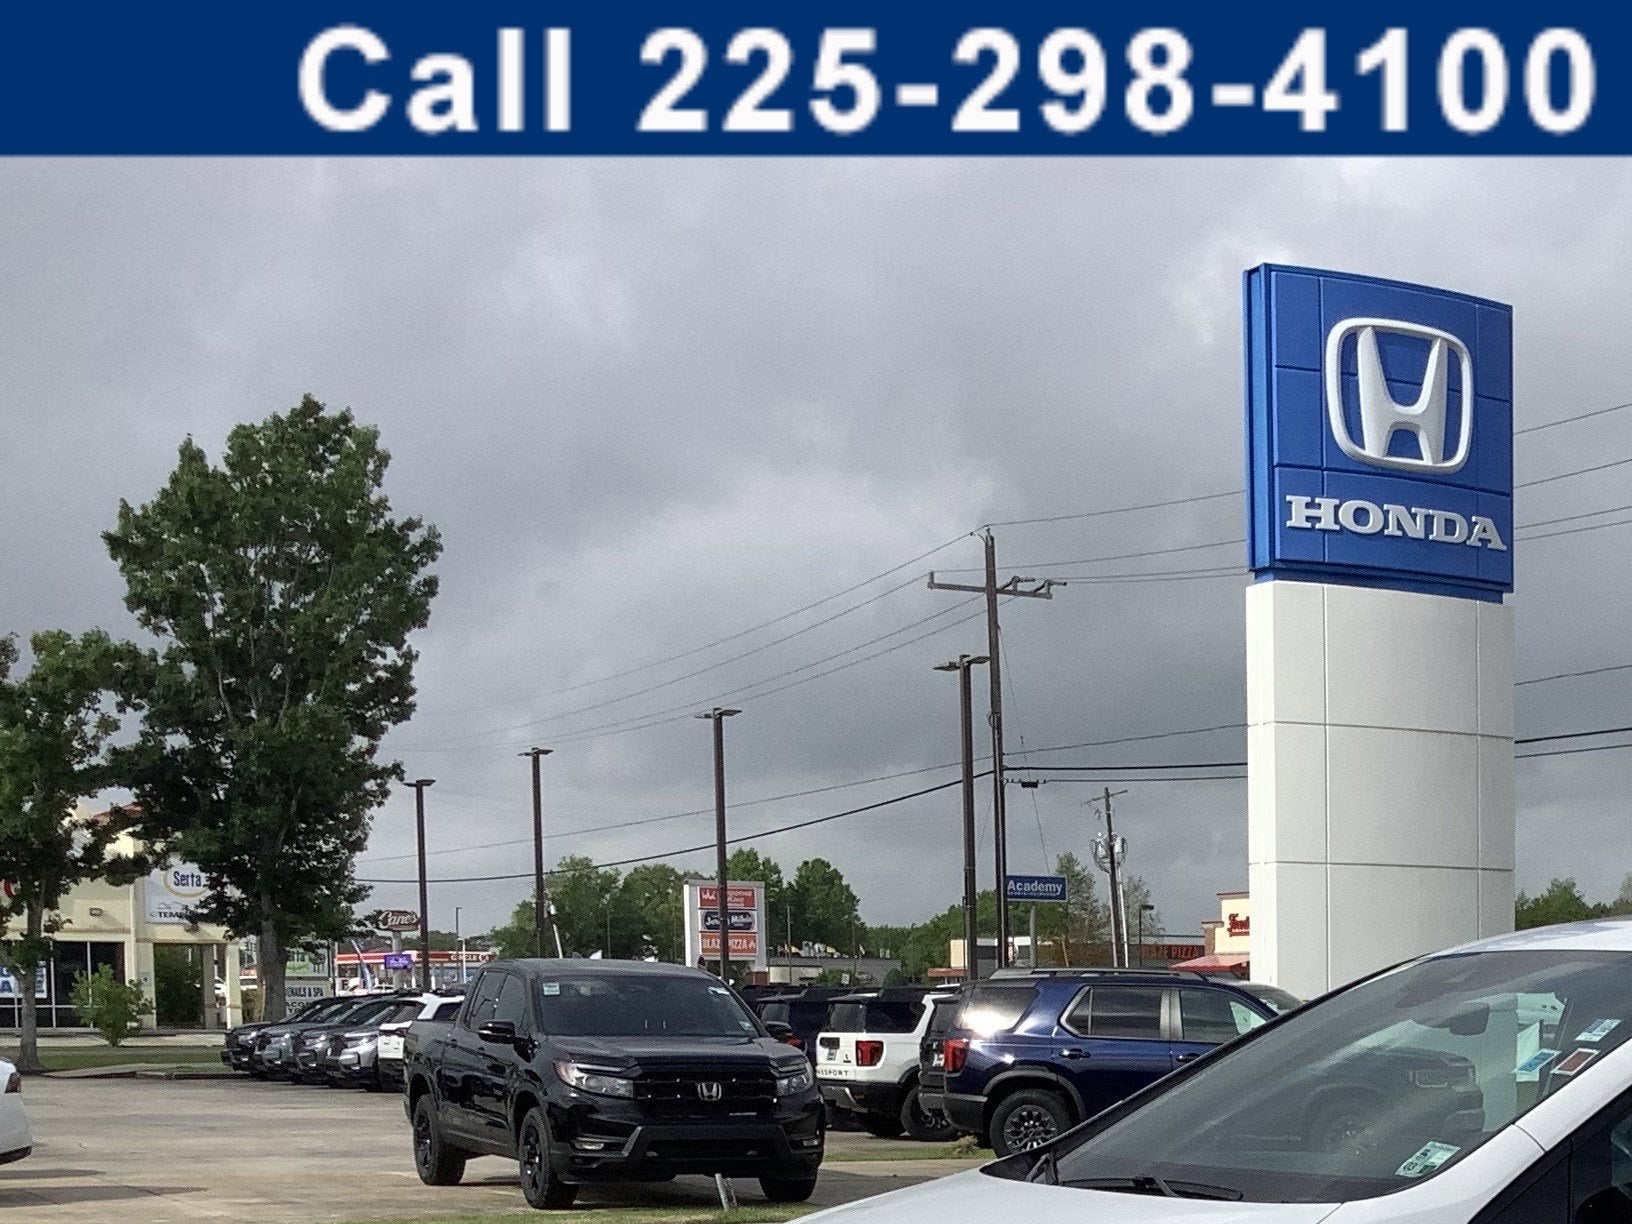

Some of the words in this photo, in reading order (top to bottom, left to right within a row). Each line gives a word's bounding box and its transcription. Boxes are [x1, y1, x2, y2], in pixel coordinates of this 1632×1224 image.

[1285, 495, 1507, 551] HONDA
[173, 870, 203, 888] Serta
[1006, 880, 1063, 896] Academy
[378, 909, 419, 930] Cane's
